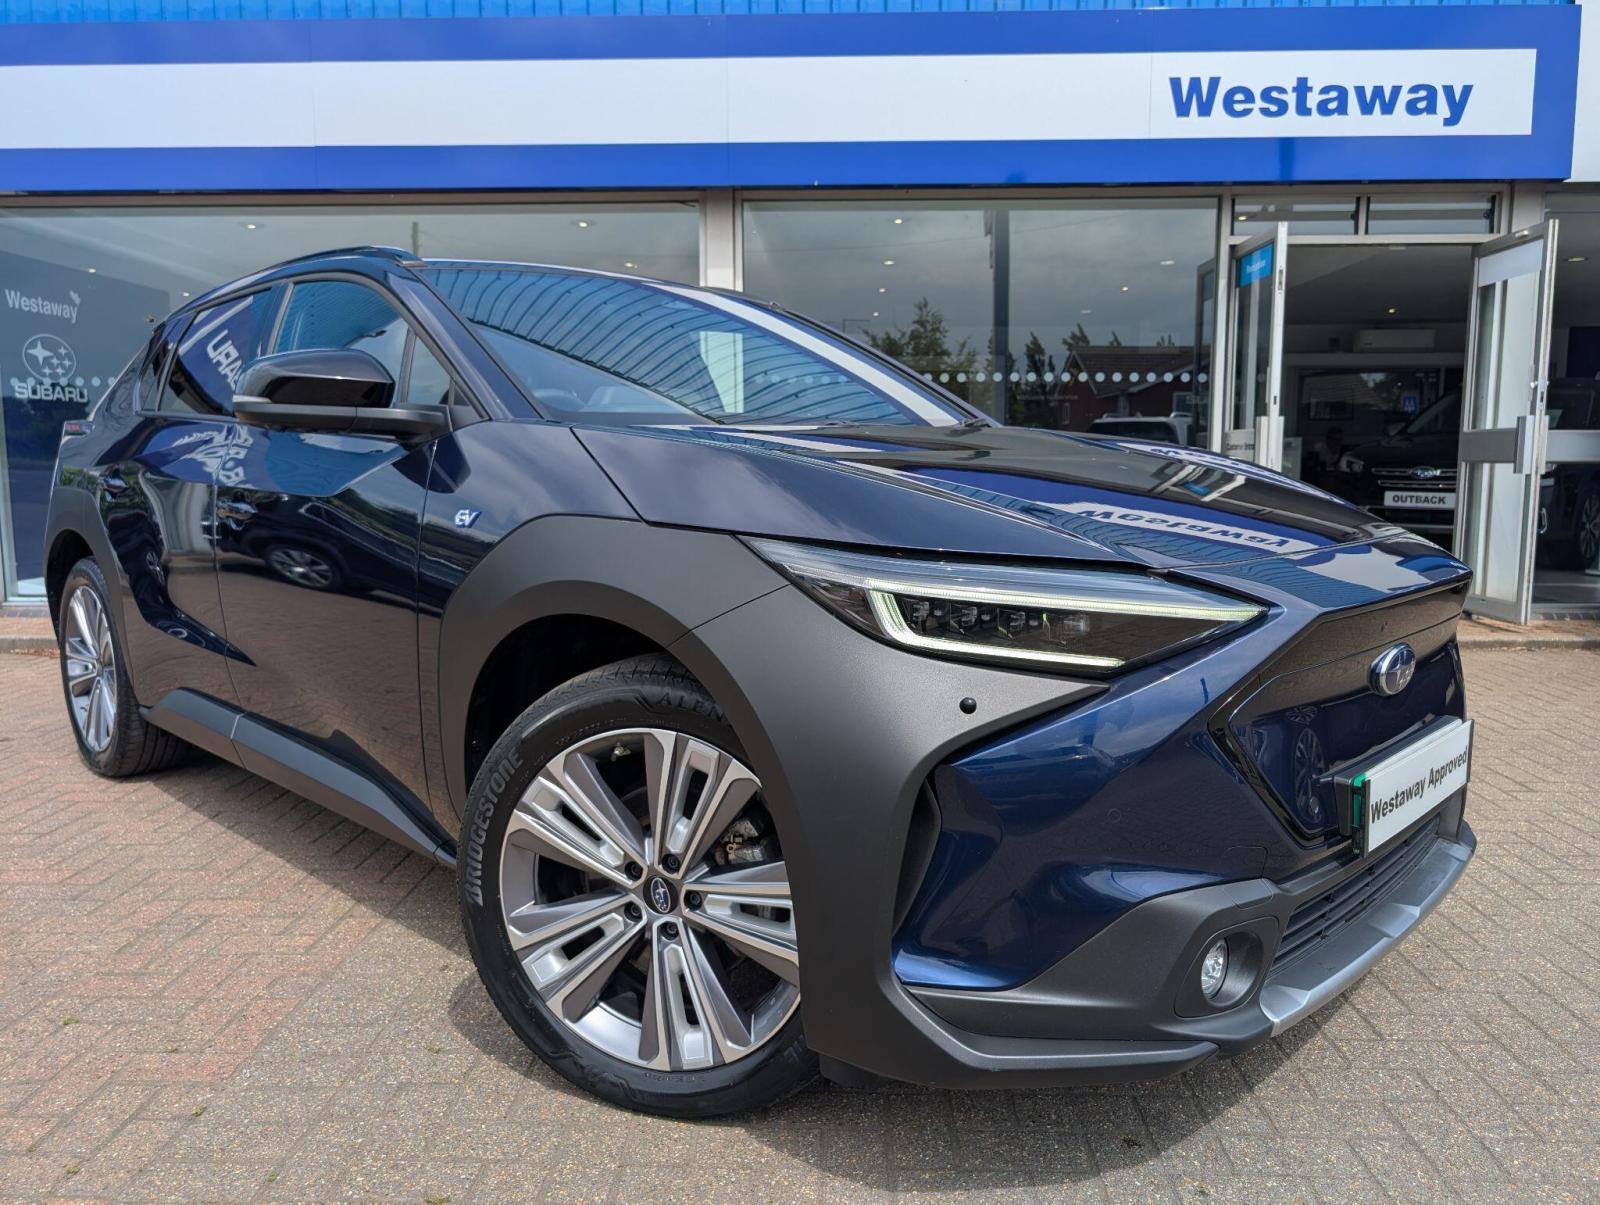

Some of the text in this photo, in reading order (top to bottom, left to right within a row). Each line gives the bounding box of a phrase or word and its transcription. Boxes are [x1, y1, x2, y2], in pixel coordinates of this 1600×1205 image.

[1169, 76, 1474, 126] Westaway
[5, 288, 78, 323] Westaway
[15, 381, 88, 402] SUBARU
[1392, 494, 1447, 505] OUTBACK
[1370, 745, 1468, 824] Westaway Approved
[464, 747, 523, 907] BRIDGESTONE
